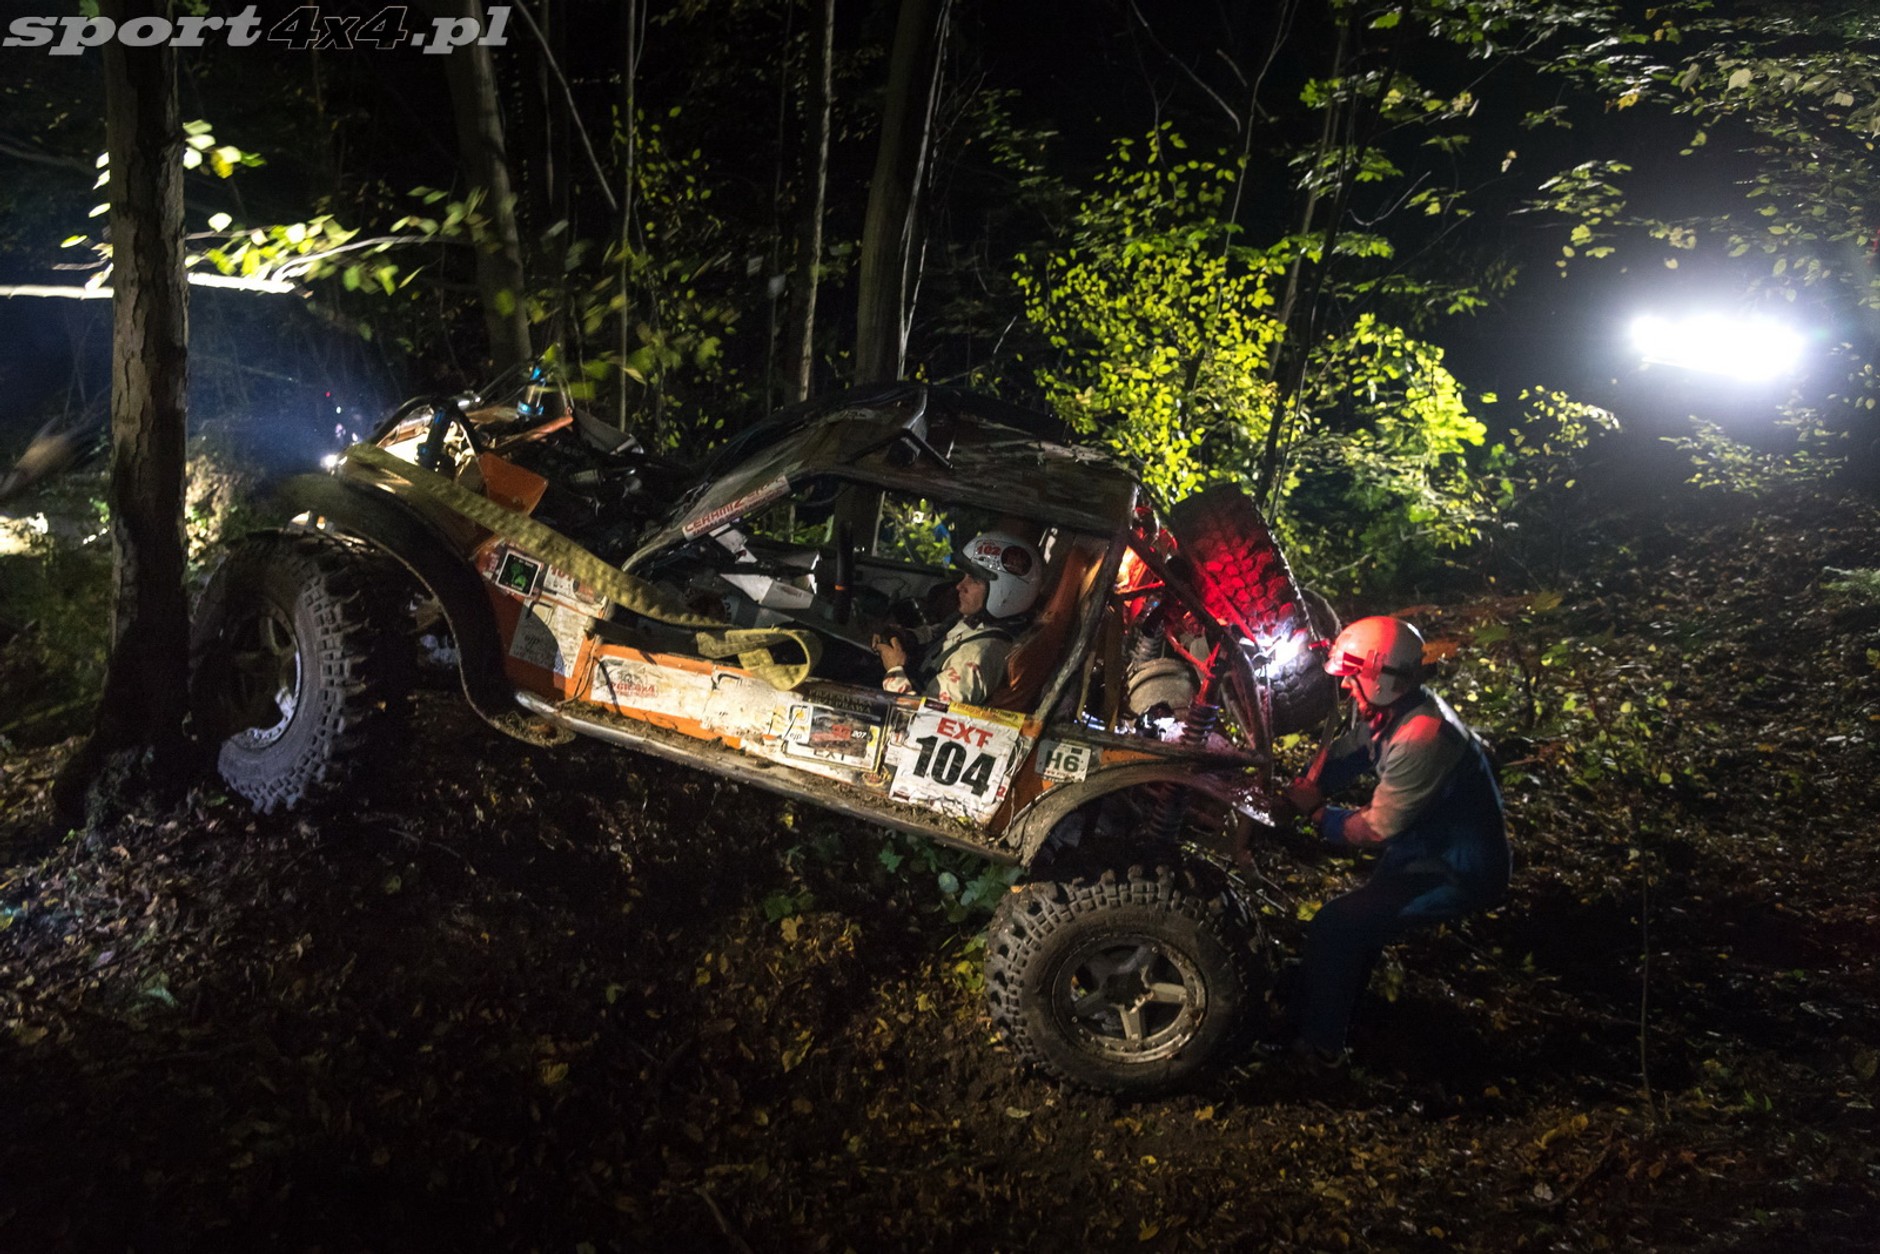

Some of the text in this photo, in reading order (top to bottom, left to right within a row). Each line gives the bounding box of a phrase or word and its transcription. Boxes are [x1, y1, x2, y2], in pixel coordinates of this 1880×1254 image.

[936, 717, 994, 749] EXT
[913, 735, 997, 797] 104
[1045, 750, 1080, 774] H6
